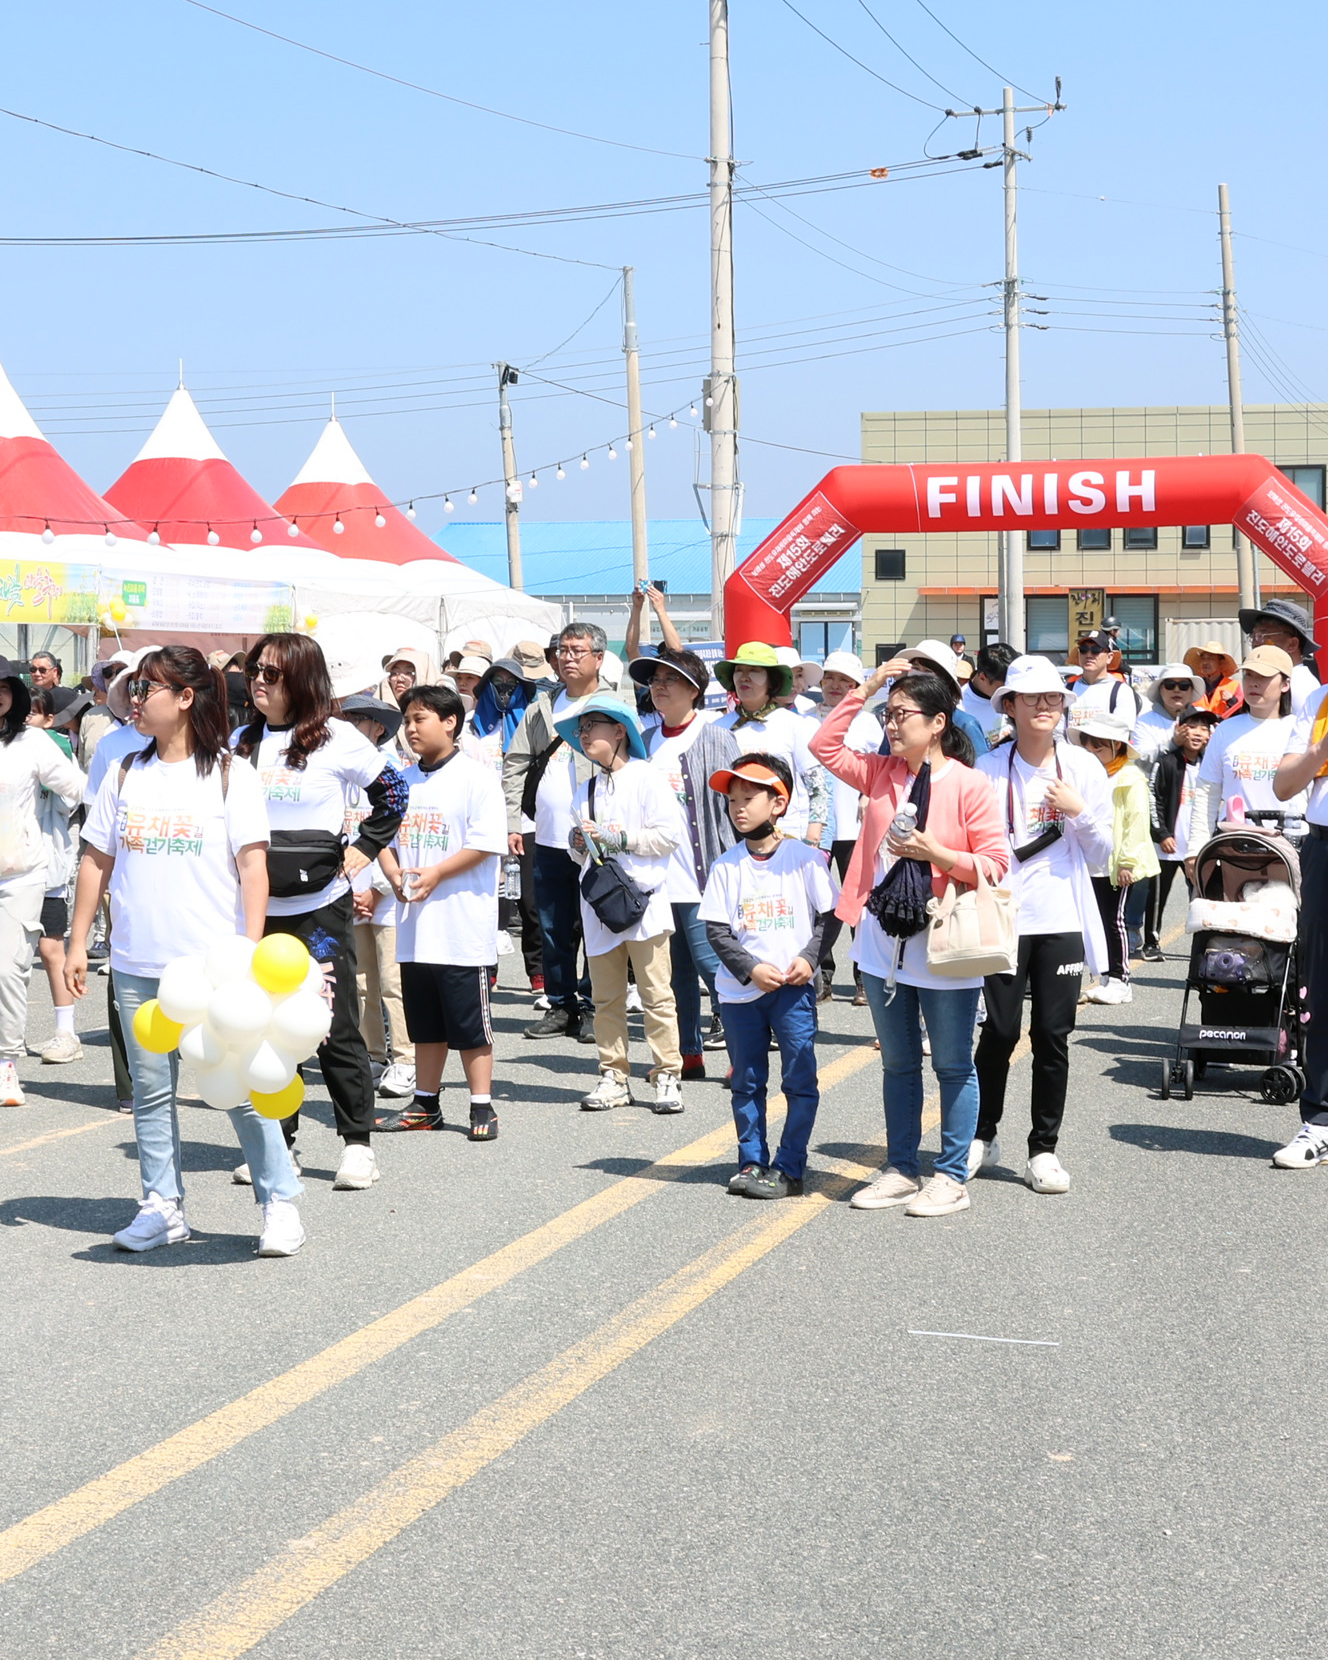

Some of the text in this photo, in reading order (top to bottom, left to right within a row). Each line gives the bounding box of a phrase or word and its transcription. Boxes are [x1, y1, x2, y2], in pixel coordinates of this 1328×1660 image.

[926, 469, 1156, 519] FINISH
[776, 534, 812, 570] 제15회
[1276, 516, 1313, 552] 제15회
